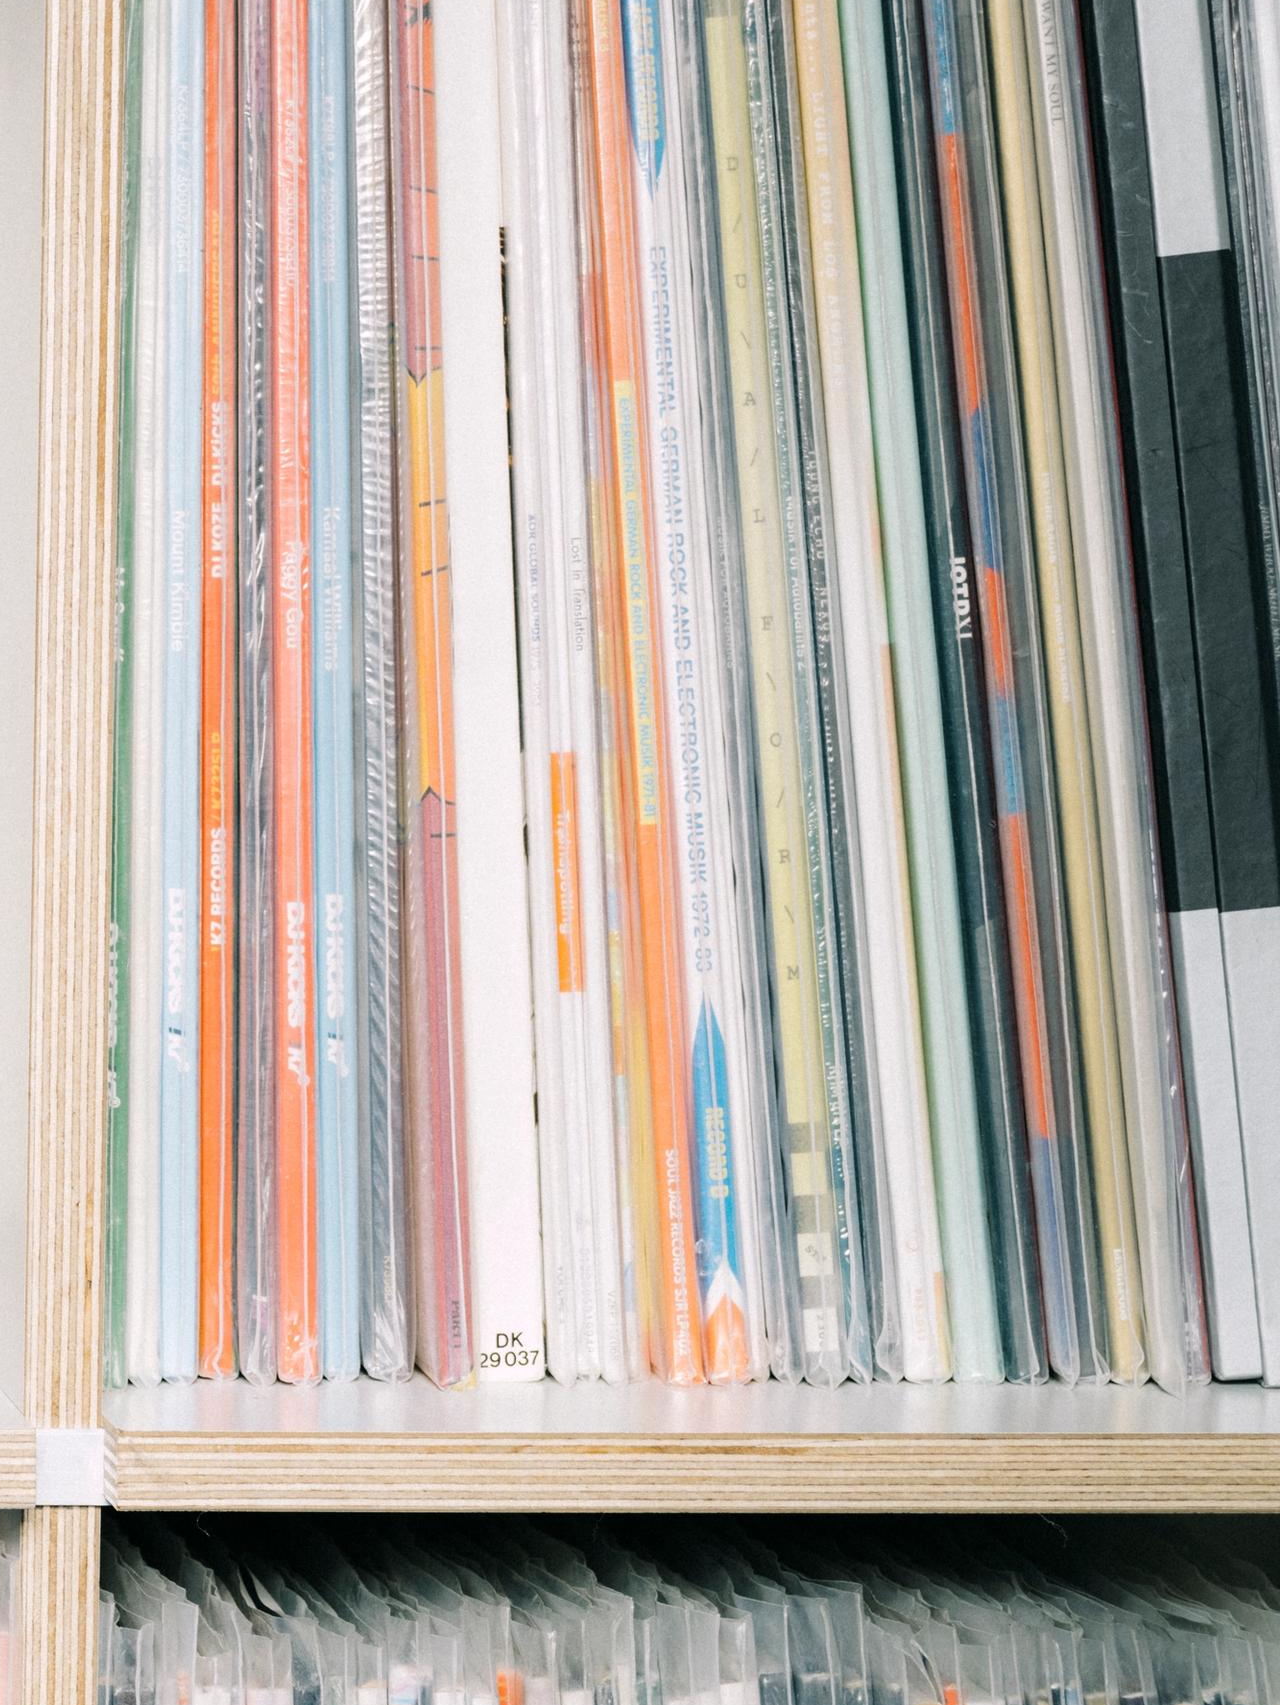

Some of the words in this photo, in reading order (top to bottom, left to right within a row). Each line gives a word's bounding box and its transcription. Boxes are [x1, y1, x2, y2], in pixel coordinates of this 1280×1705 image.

[619, 398, 636, 495] EXPERIMENTAL
[626, 500, 640, 557] GERMAN
[628, 563, 643, 600] ROCK
[632, 605, 645, 635] AND
[633, 639, 650, 719] ELECTRONIC
[637, 725, 653, 768] MUSIK
[665, 1149, 680, 1183] SOUL
[670, 1223, 685, 1284] RECORDS
[480, 1353, 502, 1367] 29
[505, 1351, 540, 1366] 037
[496, 1333, 524, 1349] DK
